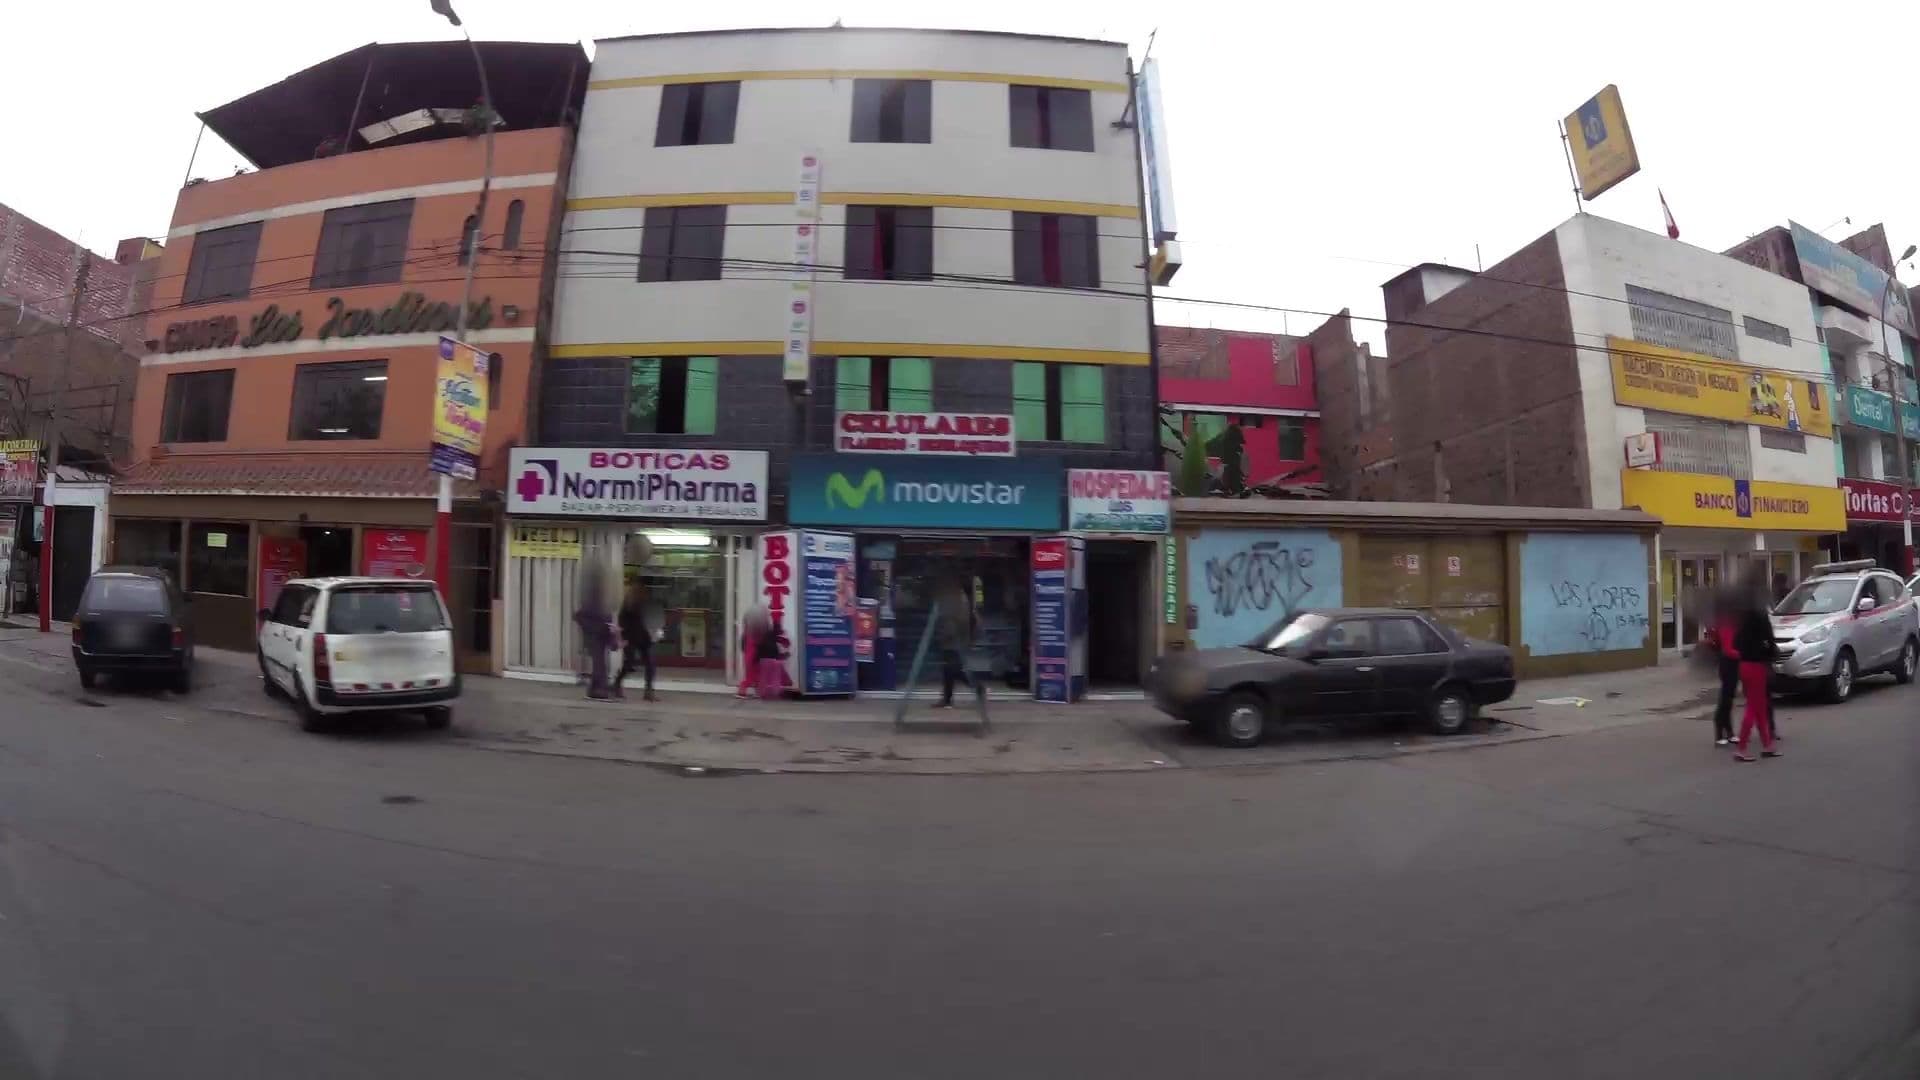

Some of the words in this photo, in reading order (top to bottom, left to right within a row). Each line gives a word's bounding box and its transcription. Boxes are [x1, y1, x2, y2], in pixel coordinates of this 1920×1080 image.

[840, 413, 1011, 436] CELULARES
[589, 452, 731, 470] BOTICAS
[562, 472, 758, 504] NormiPharma
[892, 480, 1025, 505] movistar
[1072, 471, 1170, 500] HOSPEDAJE
[1695, 492, 1734, 512] BANCO
[1753, 496, 1809, 515] FINANCIERO
[1843, 486, 1889, 514] Tortas
